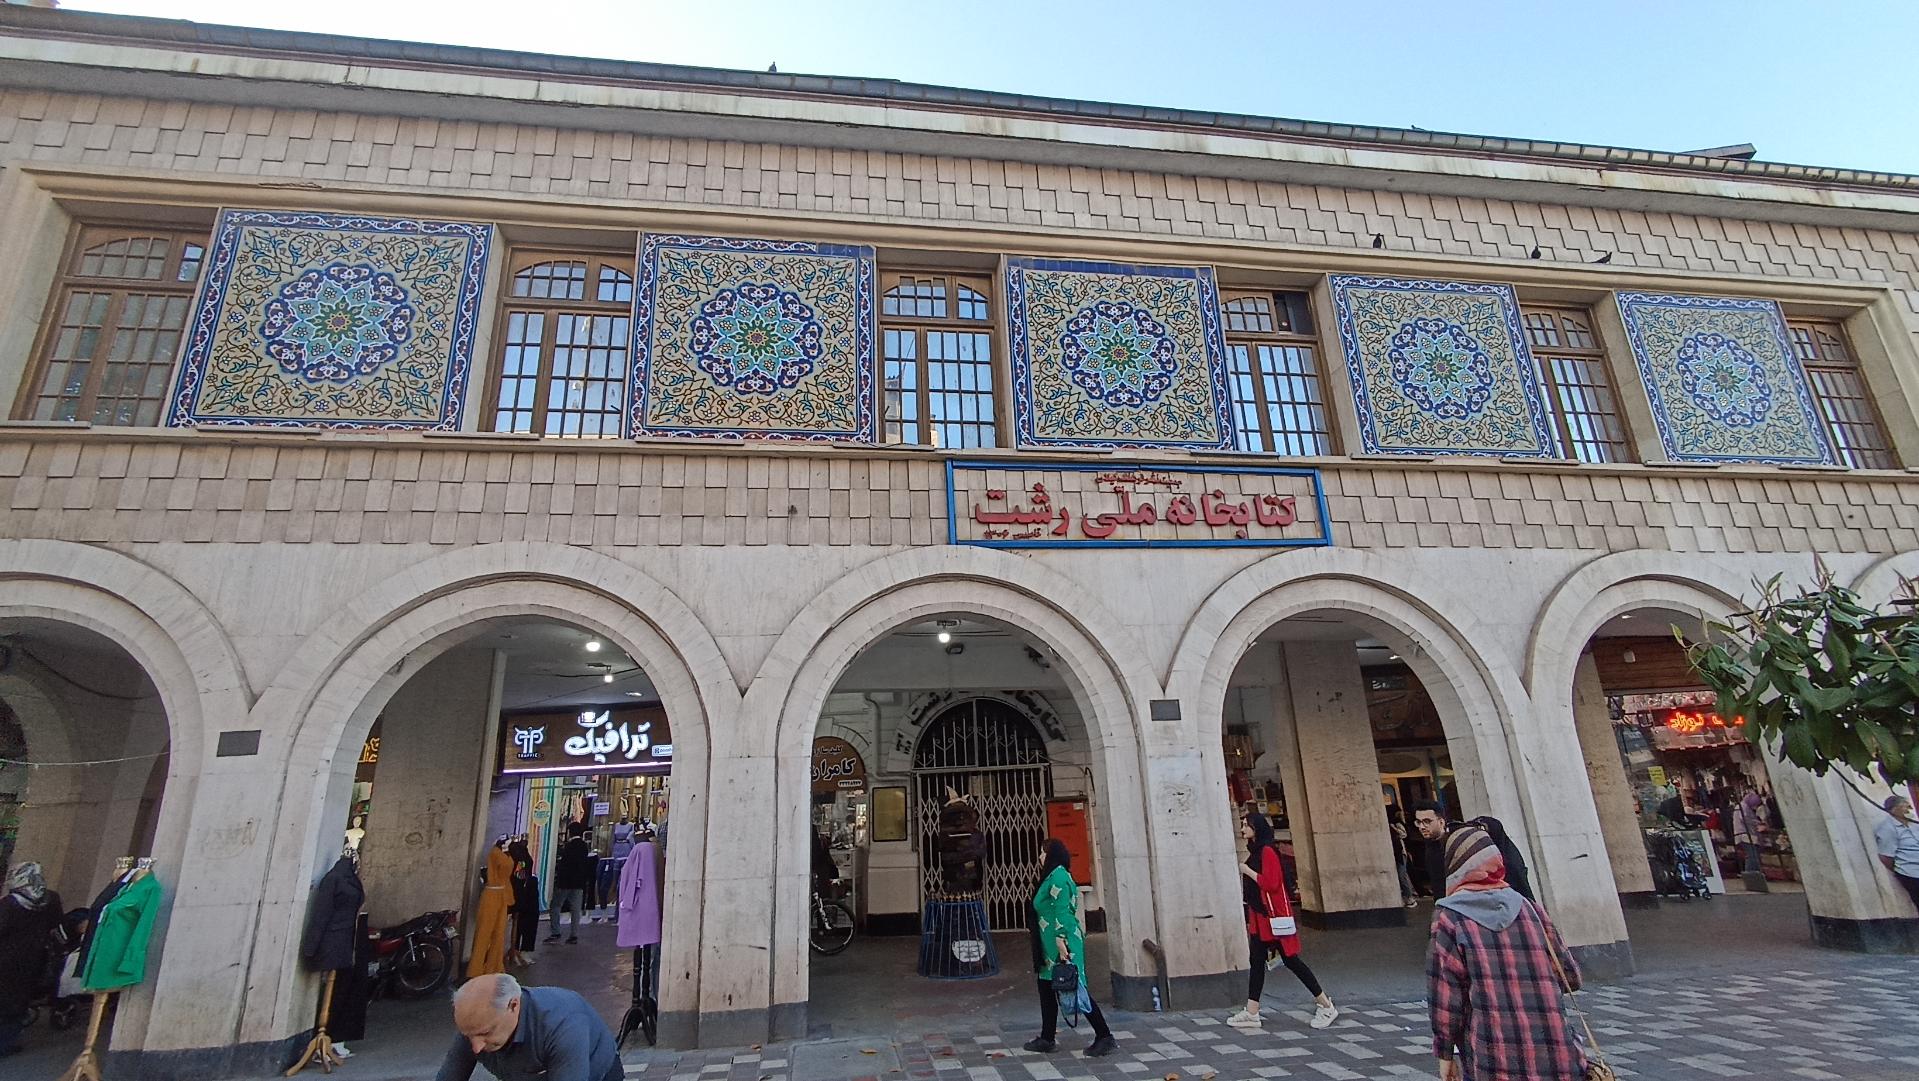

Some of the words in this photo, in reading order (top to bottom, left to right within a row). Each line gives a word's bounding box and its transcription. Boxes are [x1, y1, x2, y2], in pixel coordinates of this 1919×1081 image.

[975, 482, 1070, 536] رشت
[1166, 489, 1296, 539] کتابخانه
[564, 710, 651, 764] ترافیک
[1669, 711, 1704, 732] نوزاد
[812, 758, 857, 782] کامران
